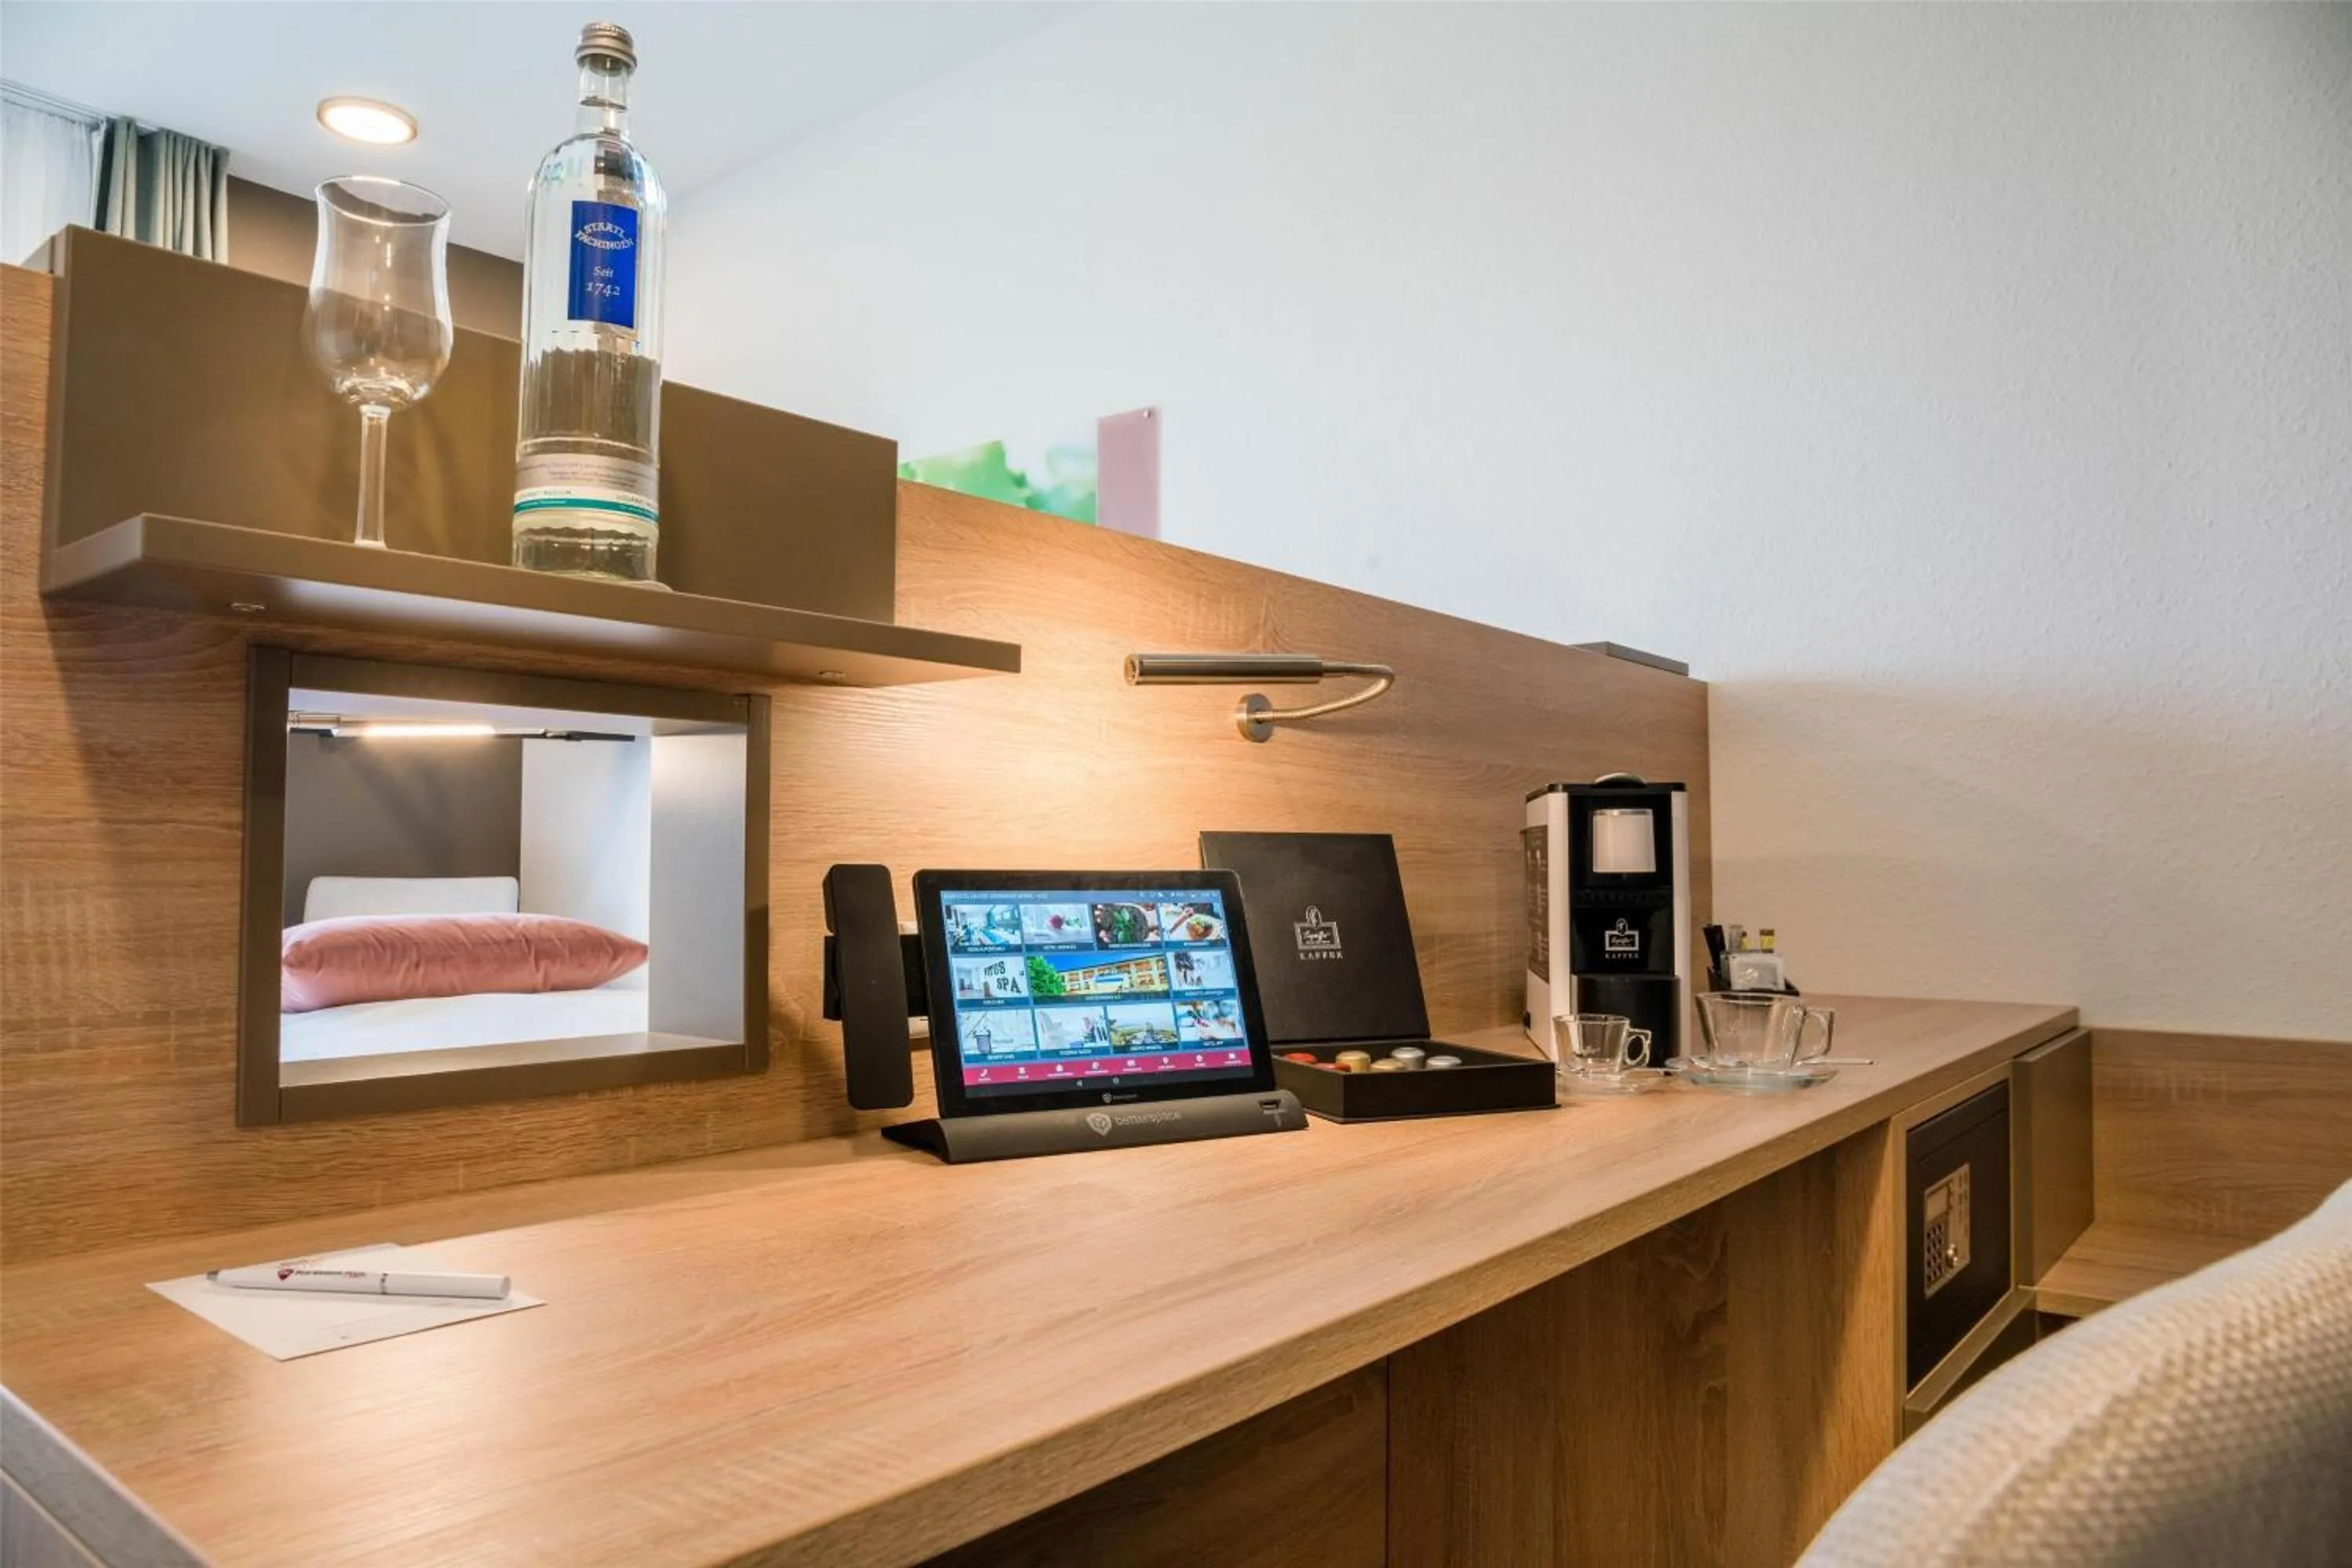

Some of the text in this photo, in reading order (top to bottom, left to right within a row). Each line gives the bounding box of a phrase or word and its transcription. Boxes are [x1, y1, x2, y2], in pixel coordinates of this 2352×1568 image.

[593, 265, 614, 277] Seit
[586, 282, 621, 297] 1742
[996, 976, 1022, 993] SPA
